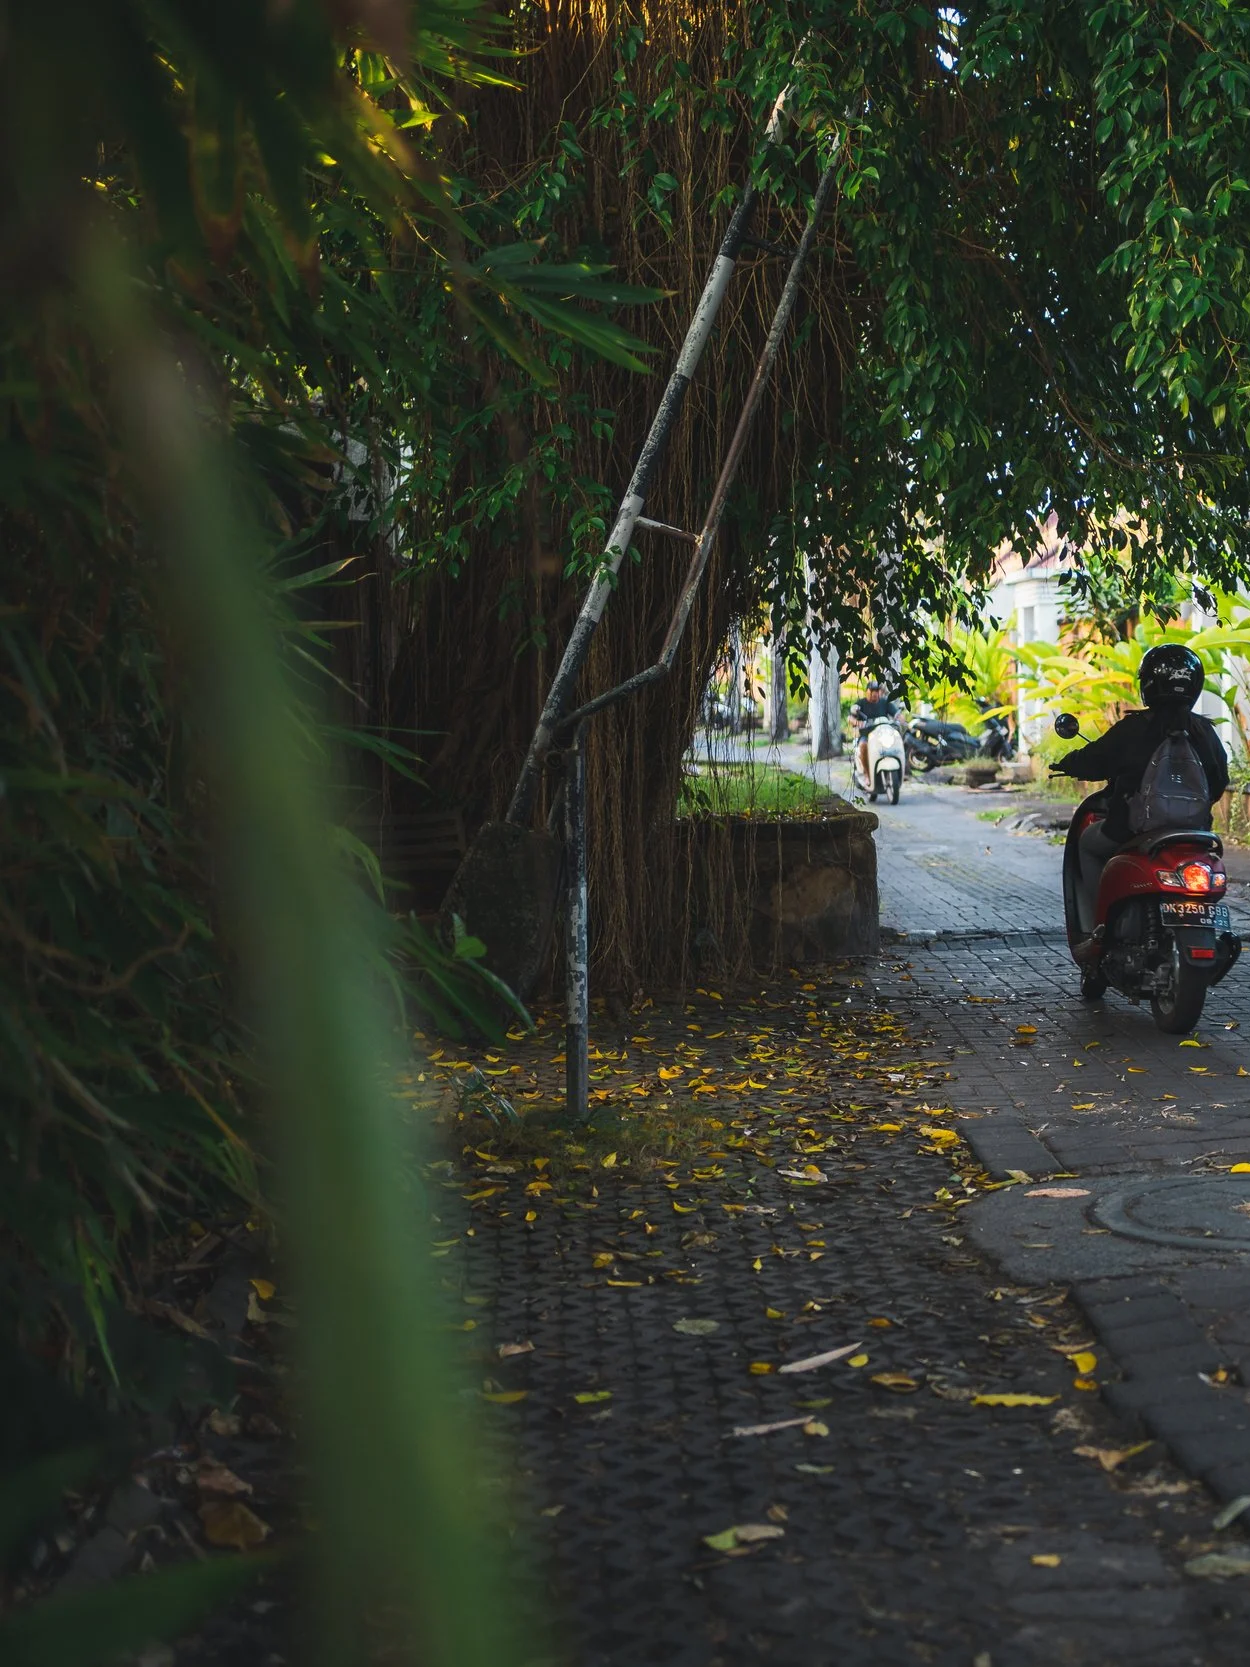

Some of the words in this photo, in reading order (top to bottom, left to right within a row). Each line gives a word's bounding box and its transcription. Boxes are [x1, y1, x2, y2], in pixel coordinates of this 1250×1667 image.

[1163, 903, 1176, 913] DK
[1178, 904, 1205, 914] 3250
[1208, 905, 1228, 917] GBB
